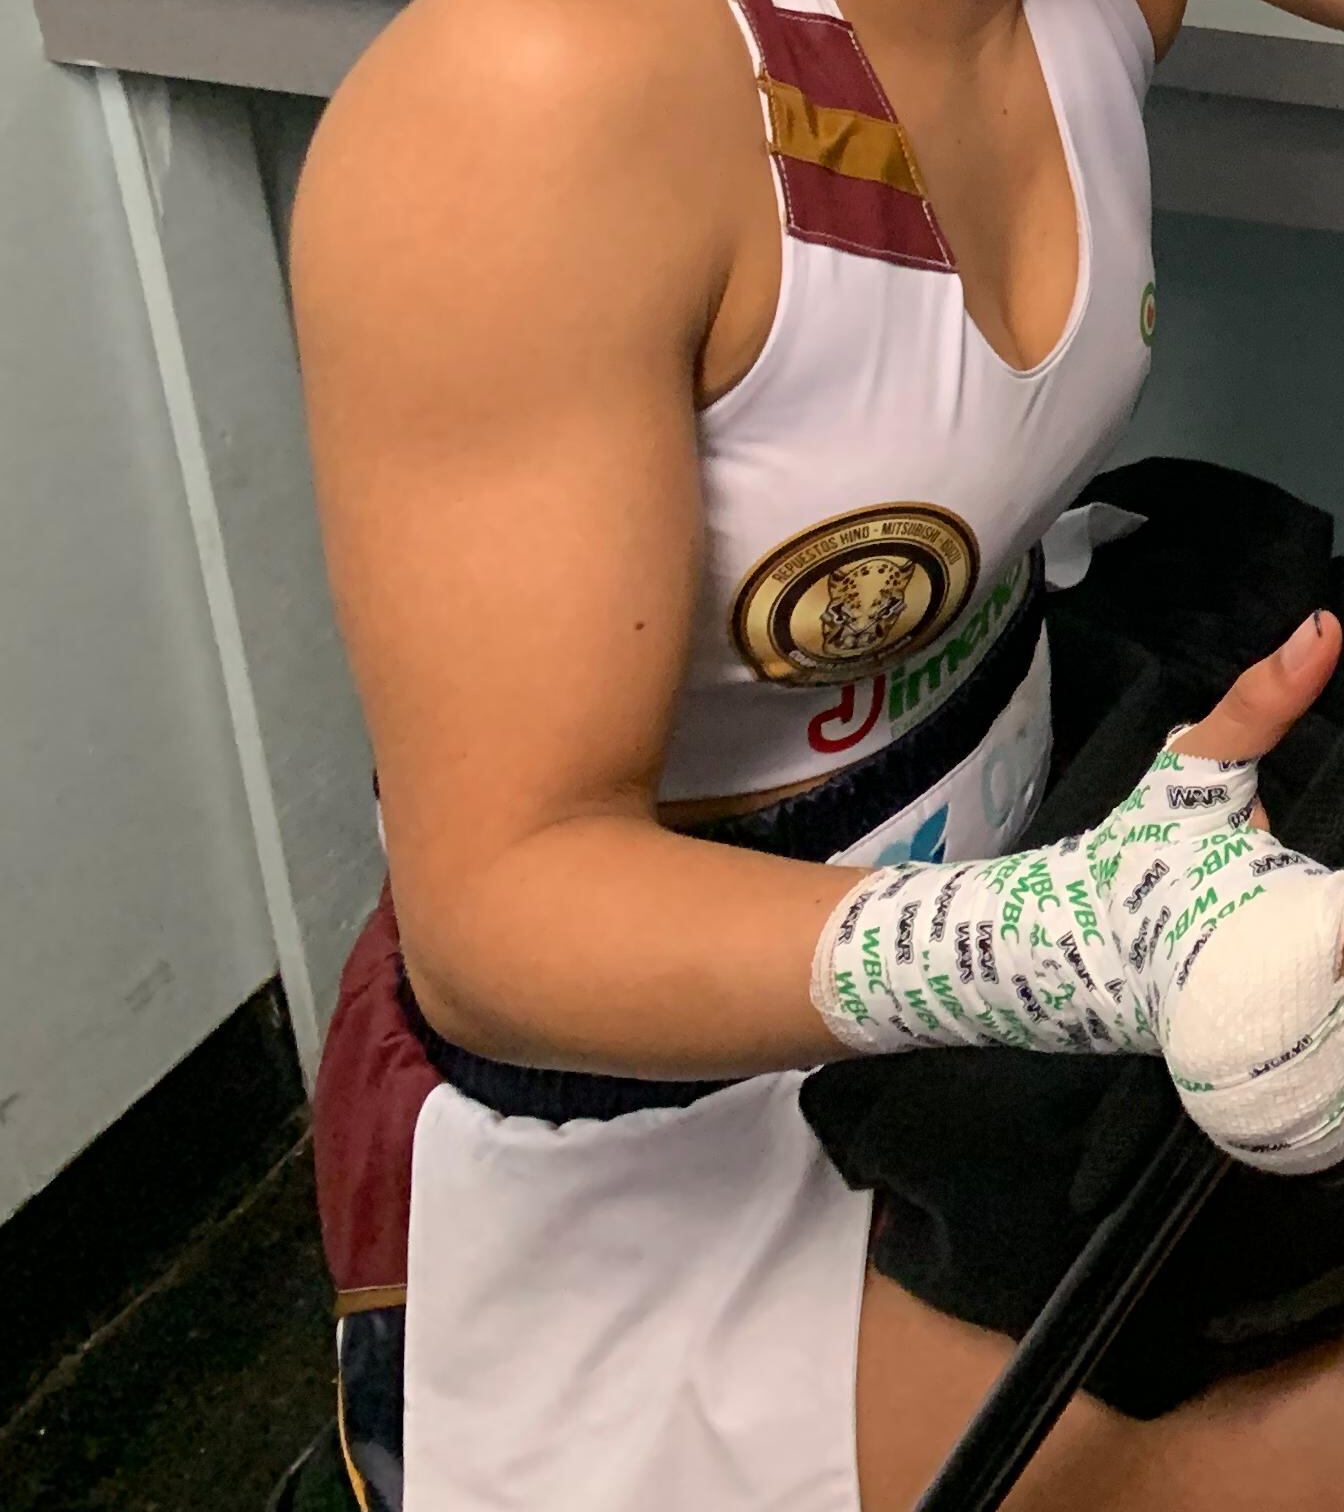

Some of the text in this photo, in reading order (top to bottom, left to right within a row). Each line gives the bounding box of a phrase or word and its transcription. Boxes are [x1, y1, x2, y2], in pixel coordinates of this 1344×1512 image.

[771, 538, 838, 584] REPUESTOS
[839, 525, 871, 546] HINO
[880, 521, 942, 544] MITSUBISHI
[1166, 784, 1231, 809] WAR
[1029, 857, 1061, 913] WBC
[1122, 858, 1170, 915] WAR
[1187, 837, 1255, 891] WBC
[895, 900, 922, 965] WAR
[1000, 876, 1029, 945] WBC
[1065, 879, 1106, 946] WBC
[1164, 886, 1219, 961] WBC
[861, 926, 890, 996] WBC
[835, 970, 880, 1027] WBC
